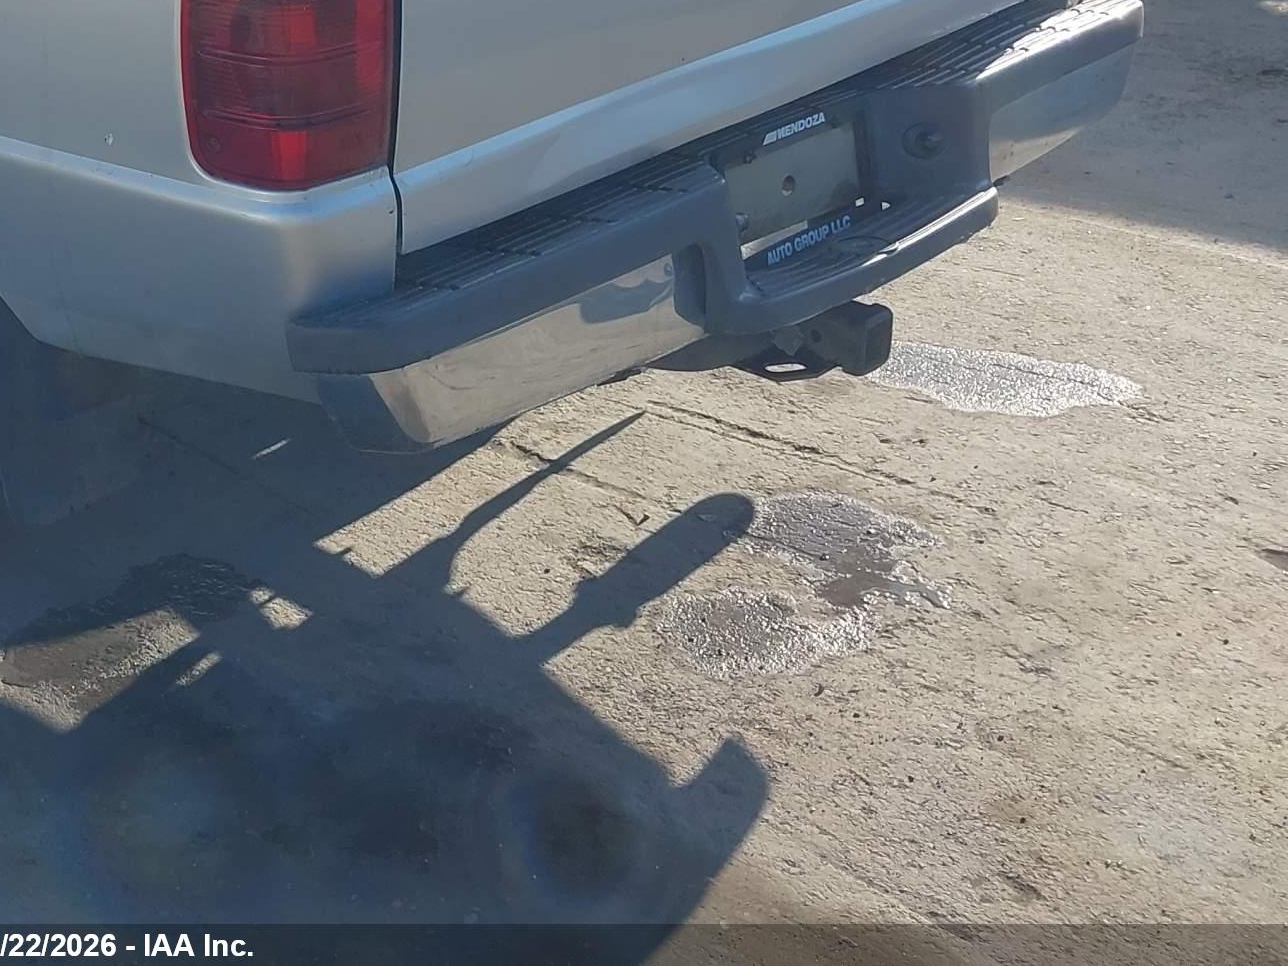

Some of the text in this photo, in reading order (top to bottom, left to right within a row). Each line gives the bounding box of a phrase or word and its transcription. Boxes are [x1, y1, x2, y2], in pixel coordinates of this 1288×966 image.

[777, 111, 826, 139] MENDOZA
[767, 215, 852, 266] AUTO GROUP LLC
